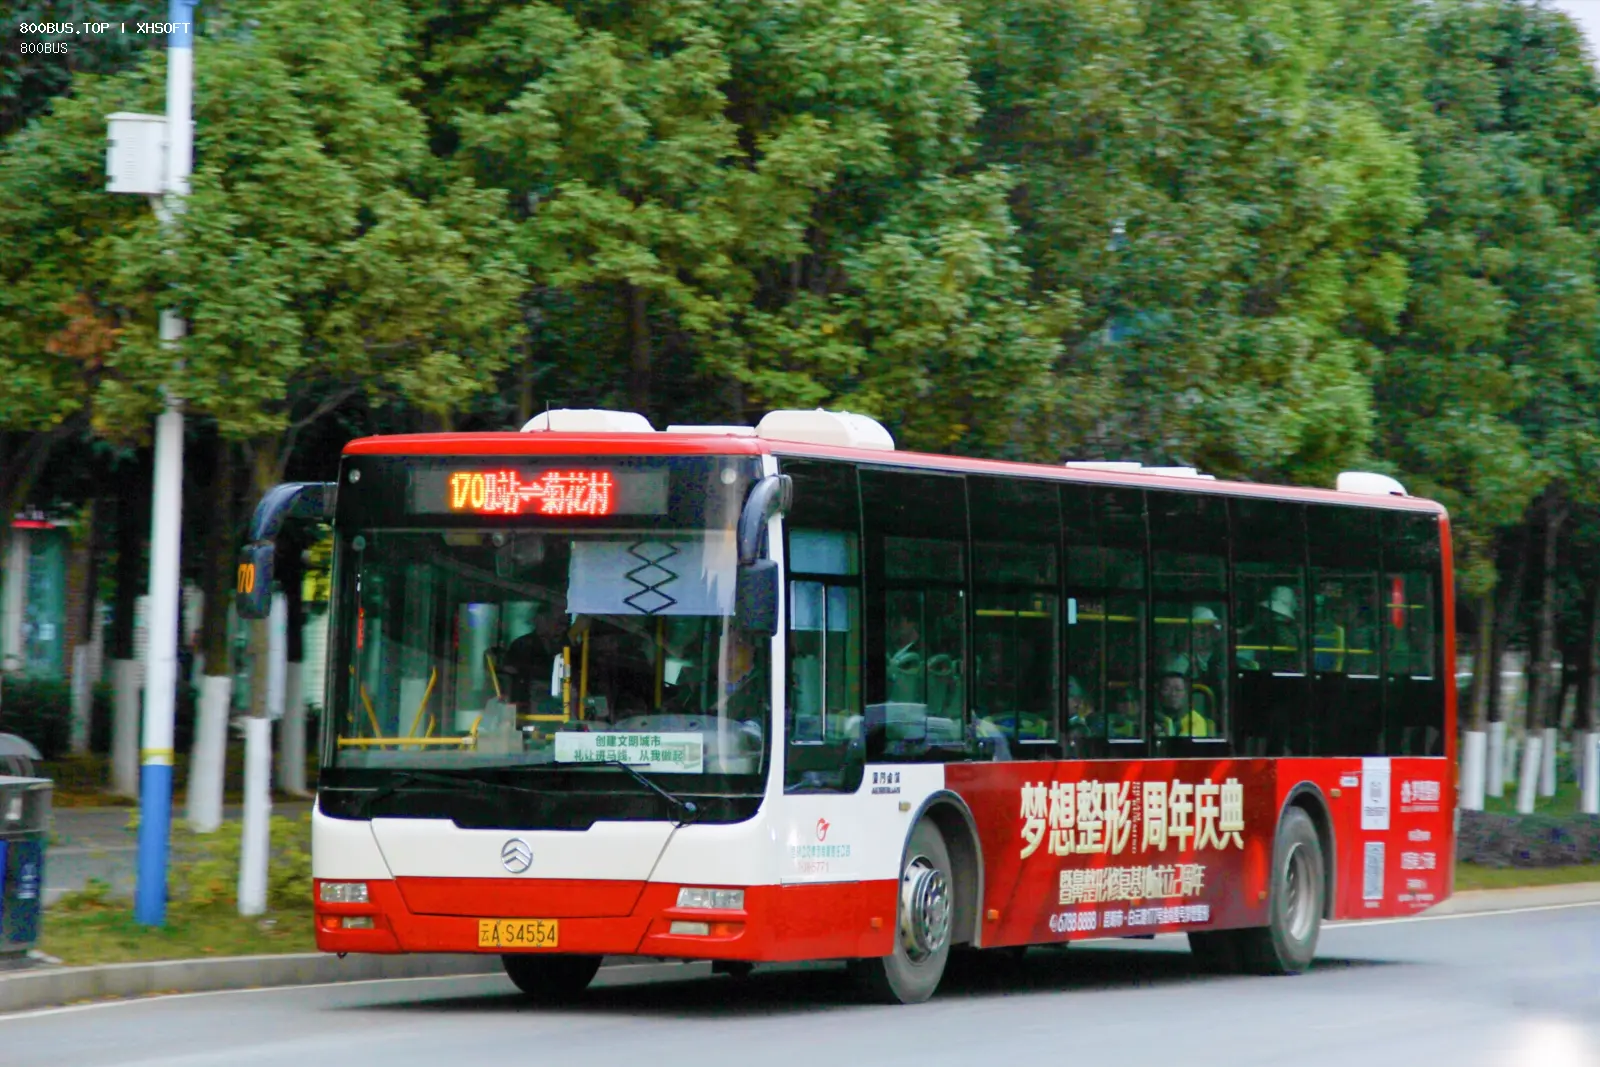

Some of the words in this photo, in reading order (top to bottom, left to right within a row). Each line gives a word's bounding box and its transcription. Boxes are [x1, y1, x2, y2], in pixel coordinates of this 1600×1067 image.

[451, 473, 485, 509] 170
[595, 735, 661, 748] 创建文明城市
[1020, 779, 1131, 860] 梦想整形
[1142, 778, 1245, 853] 周年庆典
